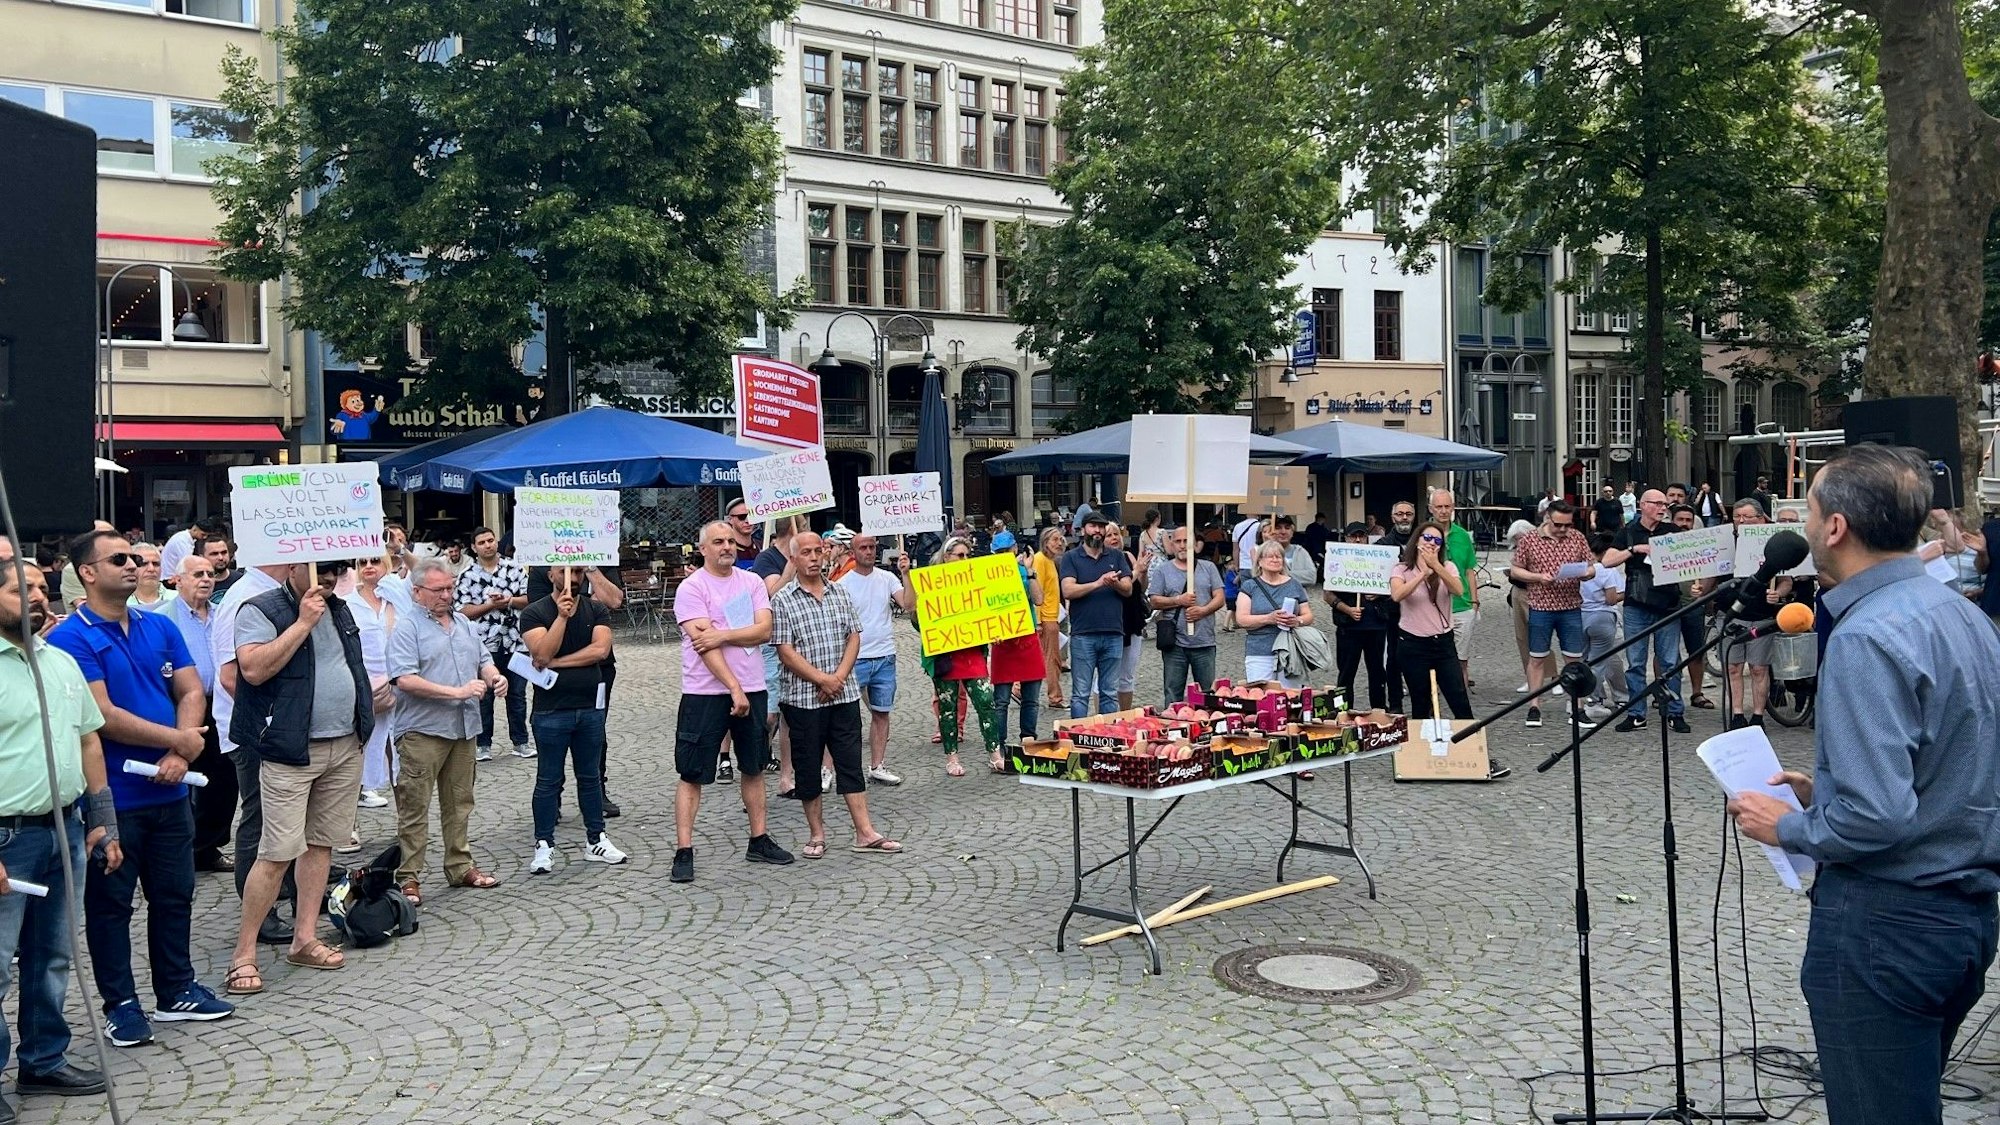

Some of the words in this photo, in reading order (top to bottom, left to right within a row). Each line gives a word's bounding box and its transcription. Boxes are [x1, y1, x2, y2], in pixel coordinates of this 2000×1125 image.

[745, 462, 763, 472] ES
[791, 451, 820, 464] KEINE
[540, 471, 579, 487] Gaffel
[580, 469, 621, 485] Kölsch
[775, 488, 803, 498] OHNE
[864, 480, 899, 493] OHNE
[281, 489, 328, 503] VOLT
[598, 495, 617, 506] VON
[242, 506, 305, 520] LASSEN
[314, 505, 346, 516] DEN
[520, 508, 608, 518] NACHHALTIGKEIT
[884, 504, 920, 515] KEINE
[521, 521, 541, 529] UND
[545, 520, 584, 529] LOKALE
[1668, 538, 1717, 551] BRAUCHEN
[1330, 547, 1391, 558] WETTBEWERB
[919, 563, 975, 593] Nehmt
[986, 563, 1014, 580] uns
[925, 586, 987, 620] NICHT
[986, 590, 1023, 607] unsere
[925, 609, 1029, 654] EXISTENZ
[1078, 734, 1115, 747] PRIMOR
[1157, 763, 1203, 783] Magda
